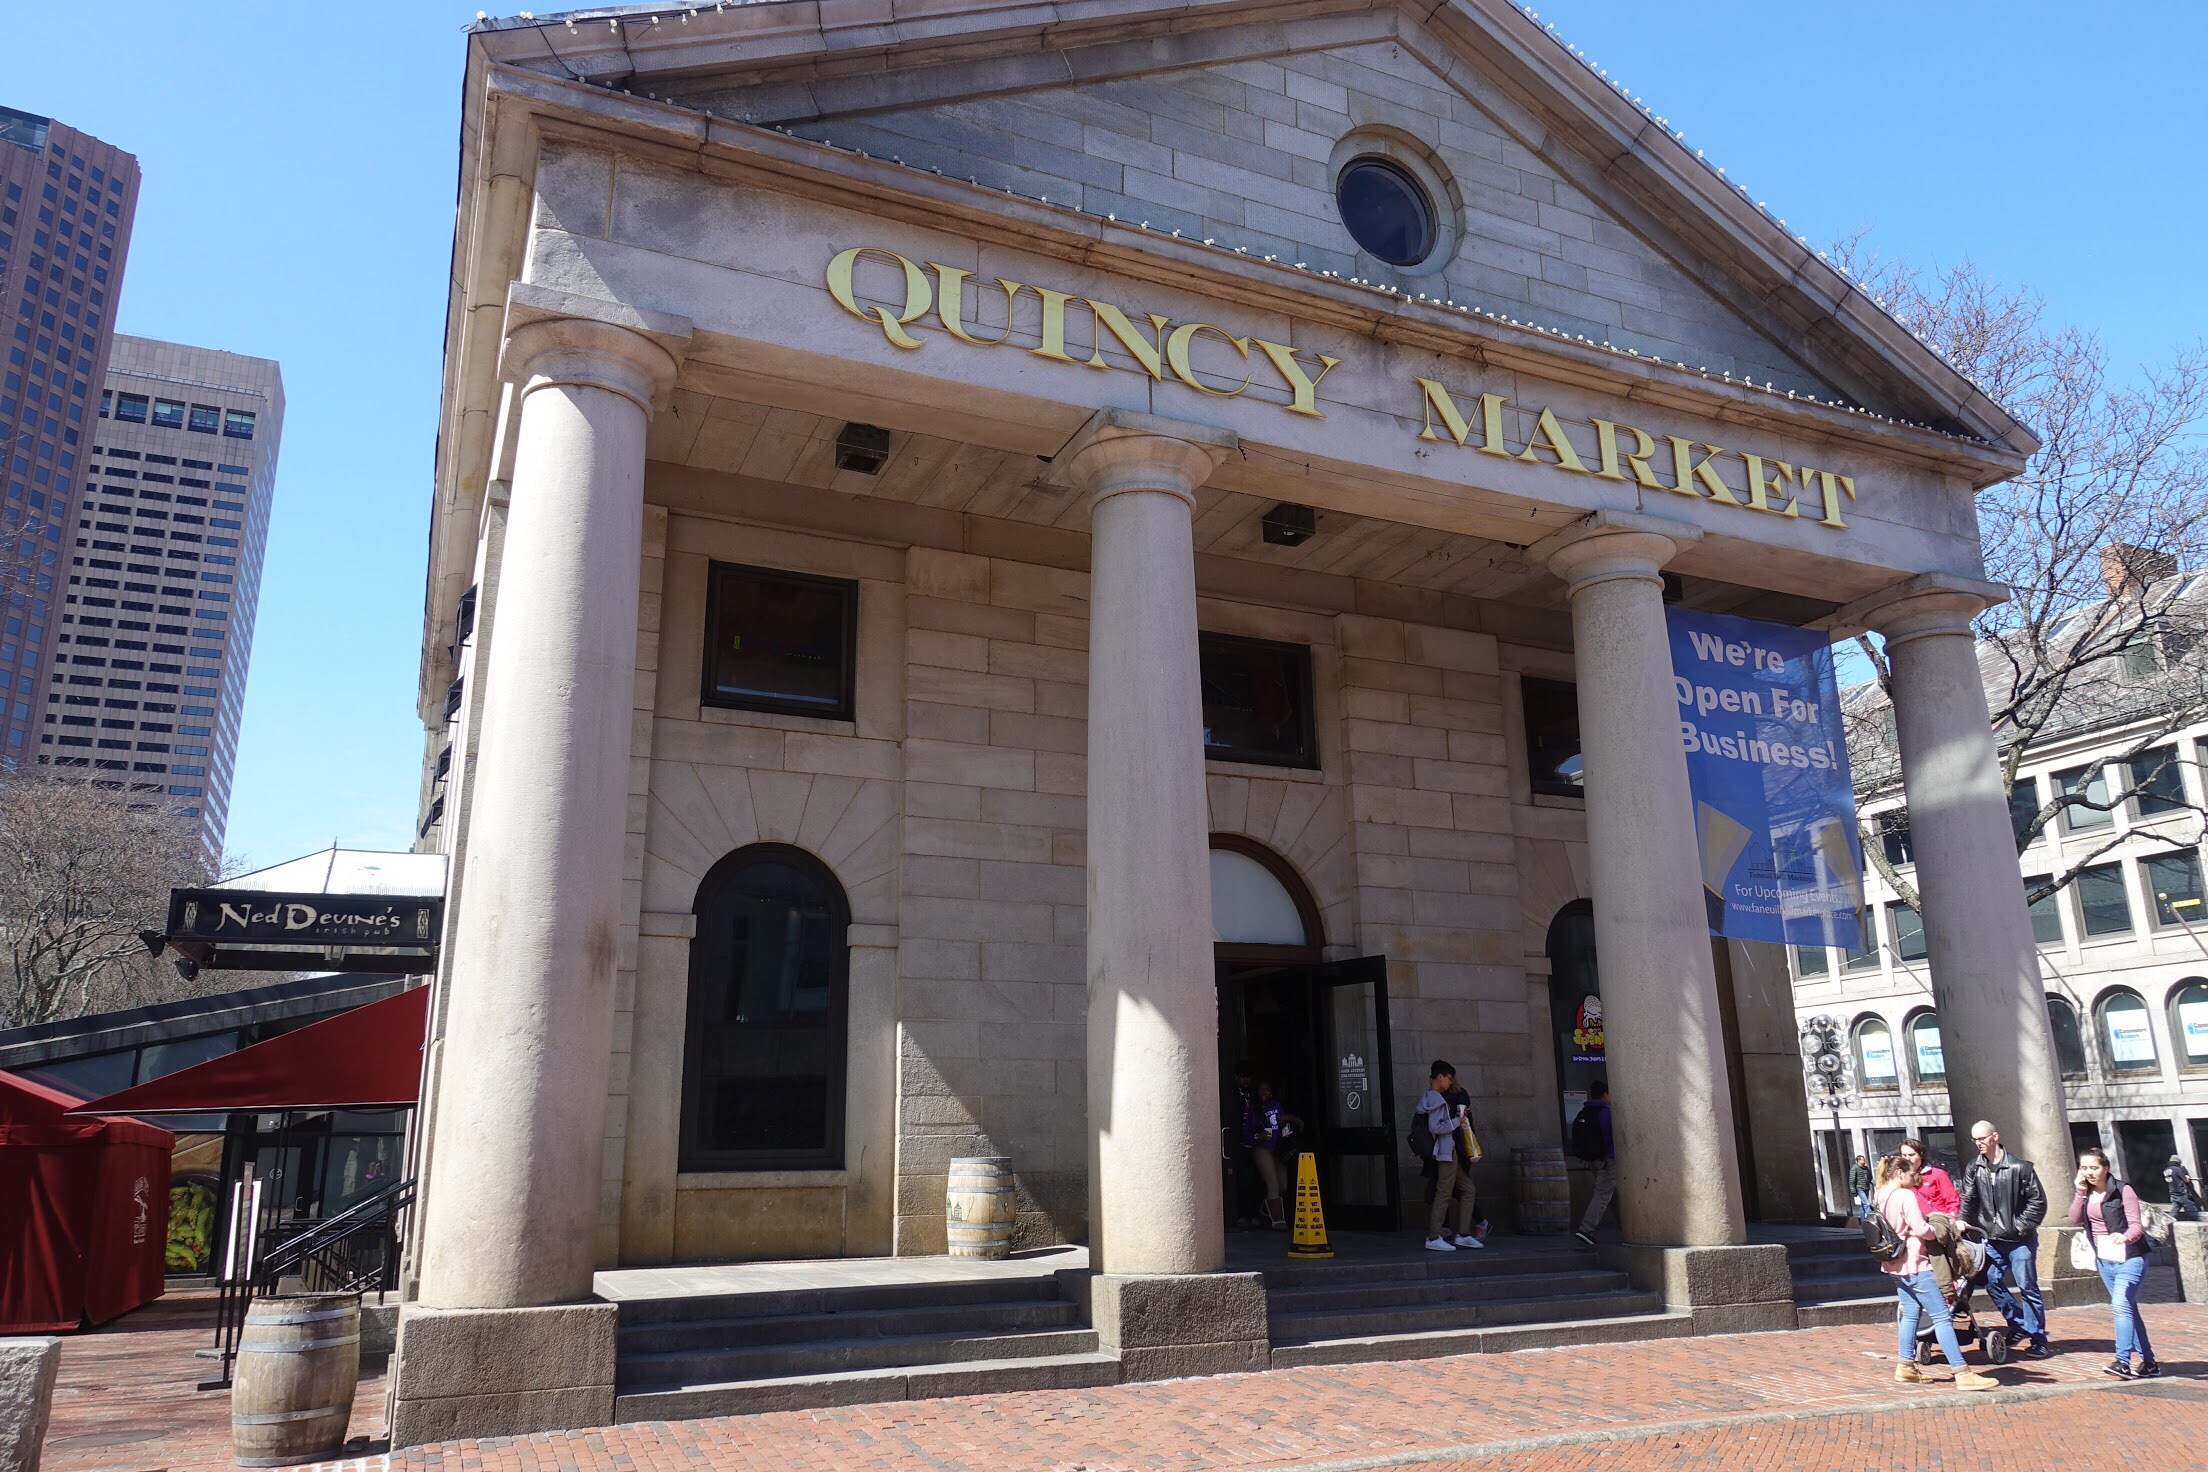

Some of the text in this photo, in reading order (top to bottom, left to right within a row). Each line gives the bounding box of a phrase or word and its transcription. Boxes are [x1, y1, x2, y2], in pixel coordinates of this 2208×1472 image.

[825, 247, 1857, 529] QUINCY MARKET
[1688, 630, 1785, 674] We're
[1771, 687, 1819, 724] For
[1681, 721, 1838, 770] Business!
[1735, 883, 1752, 897] For
[1755, 885, 1808, 904] Upcoming
[215, 903, 281, 931] Ned
[1731, 902, 1853, 920] www.faneuilhallmarketplace.com
[364, 927, 391, 938] pub
